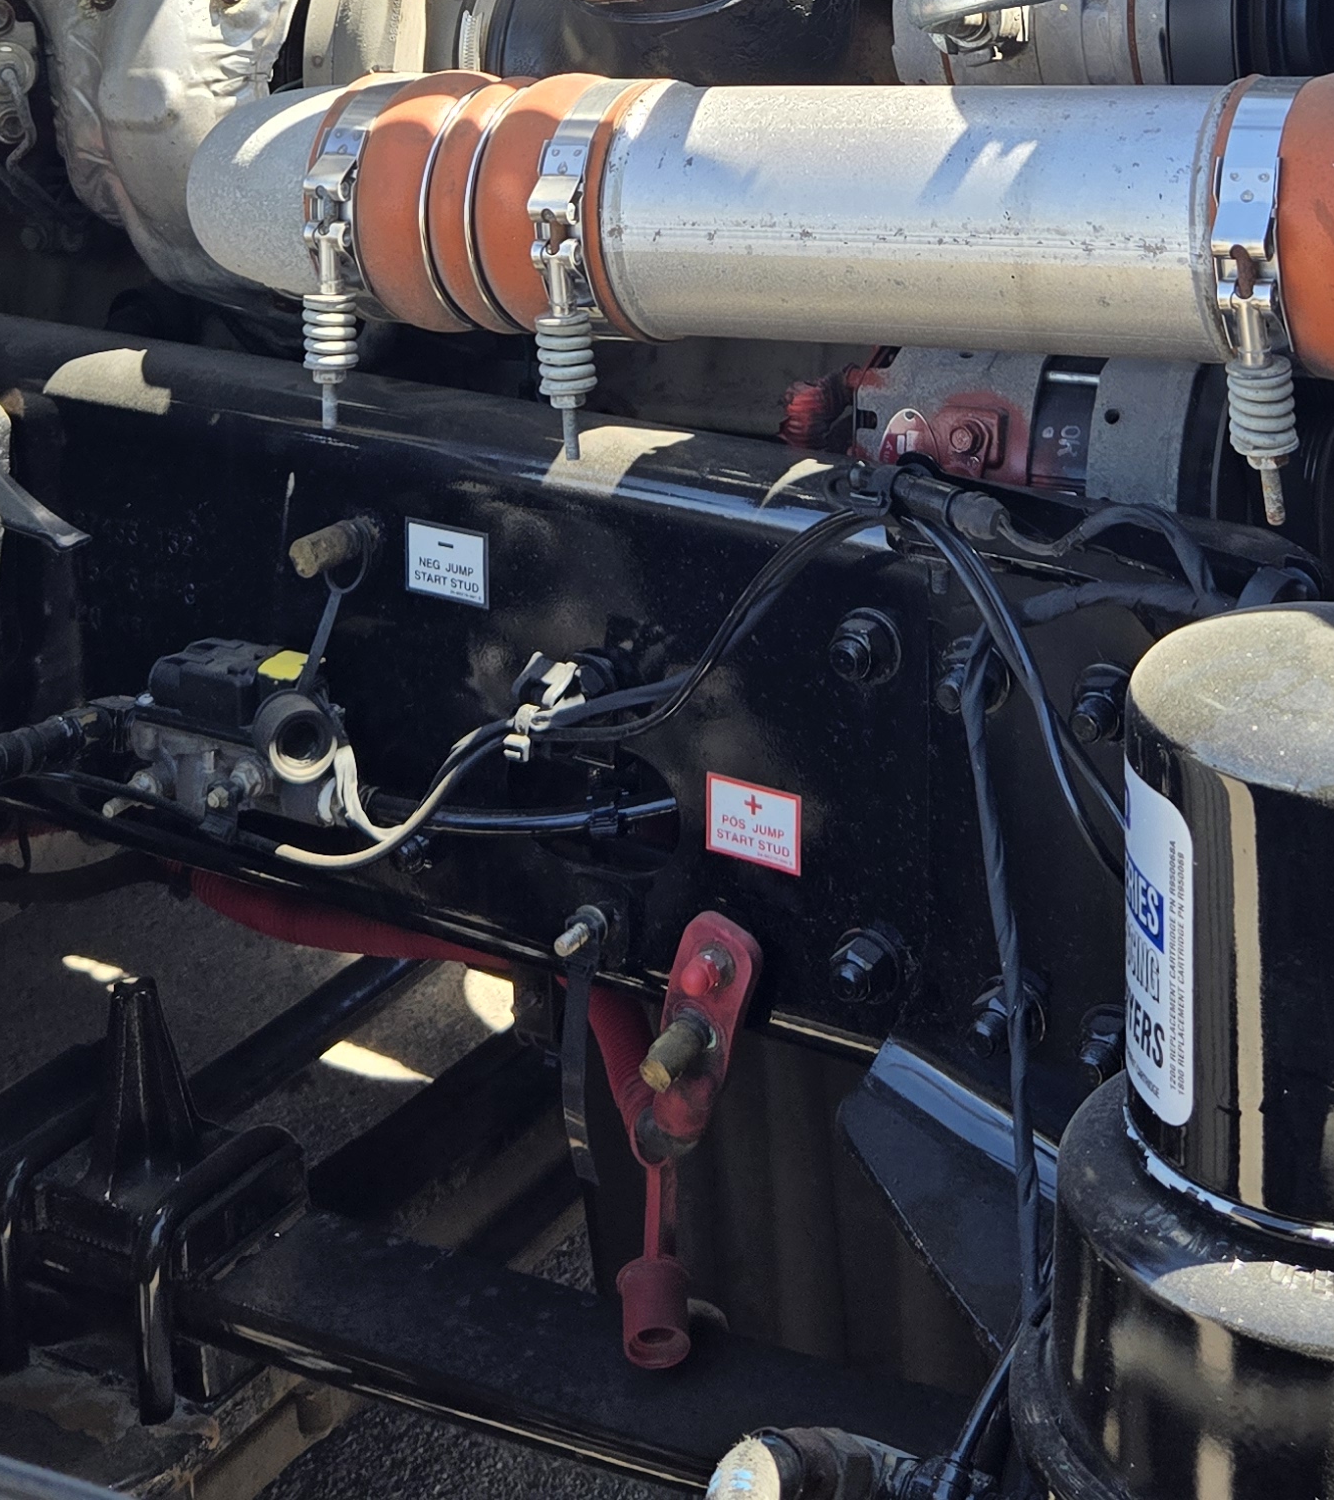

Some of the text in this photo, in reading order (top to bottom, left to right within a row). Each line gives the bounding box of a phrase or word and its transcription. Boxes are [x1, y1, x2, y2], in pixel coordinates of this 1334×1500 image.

[419, 556, 474, 576] NEG JUMP
[415, 570, 479, 593] START STUD
[722, 814, 785, 839] POS JUMP
[717, 828, 790, 858] START STUD
[1125, 852, 1159, 936] RIES
[1169, 898, 1175, 913] PN
[1177, 904, 1184, 918] PN
[1169, 918, 1177, 978] CARTRIDGE
[1177, 922, 1185, 984] CARTRIDGE
[1126, 990, 1165, 1069] YERS
[1169, 982, 1177, 1062] REPLACEMENT
[1177, 987, 1185, 1066] REPLACEMENT
[1177, 1072, 1185, 1096] 1800
